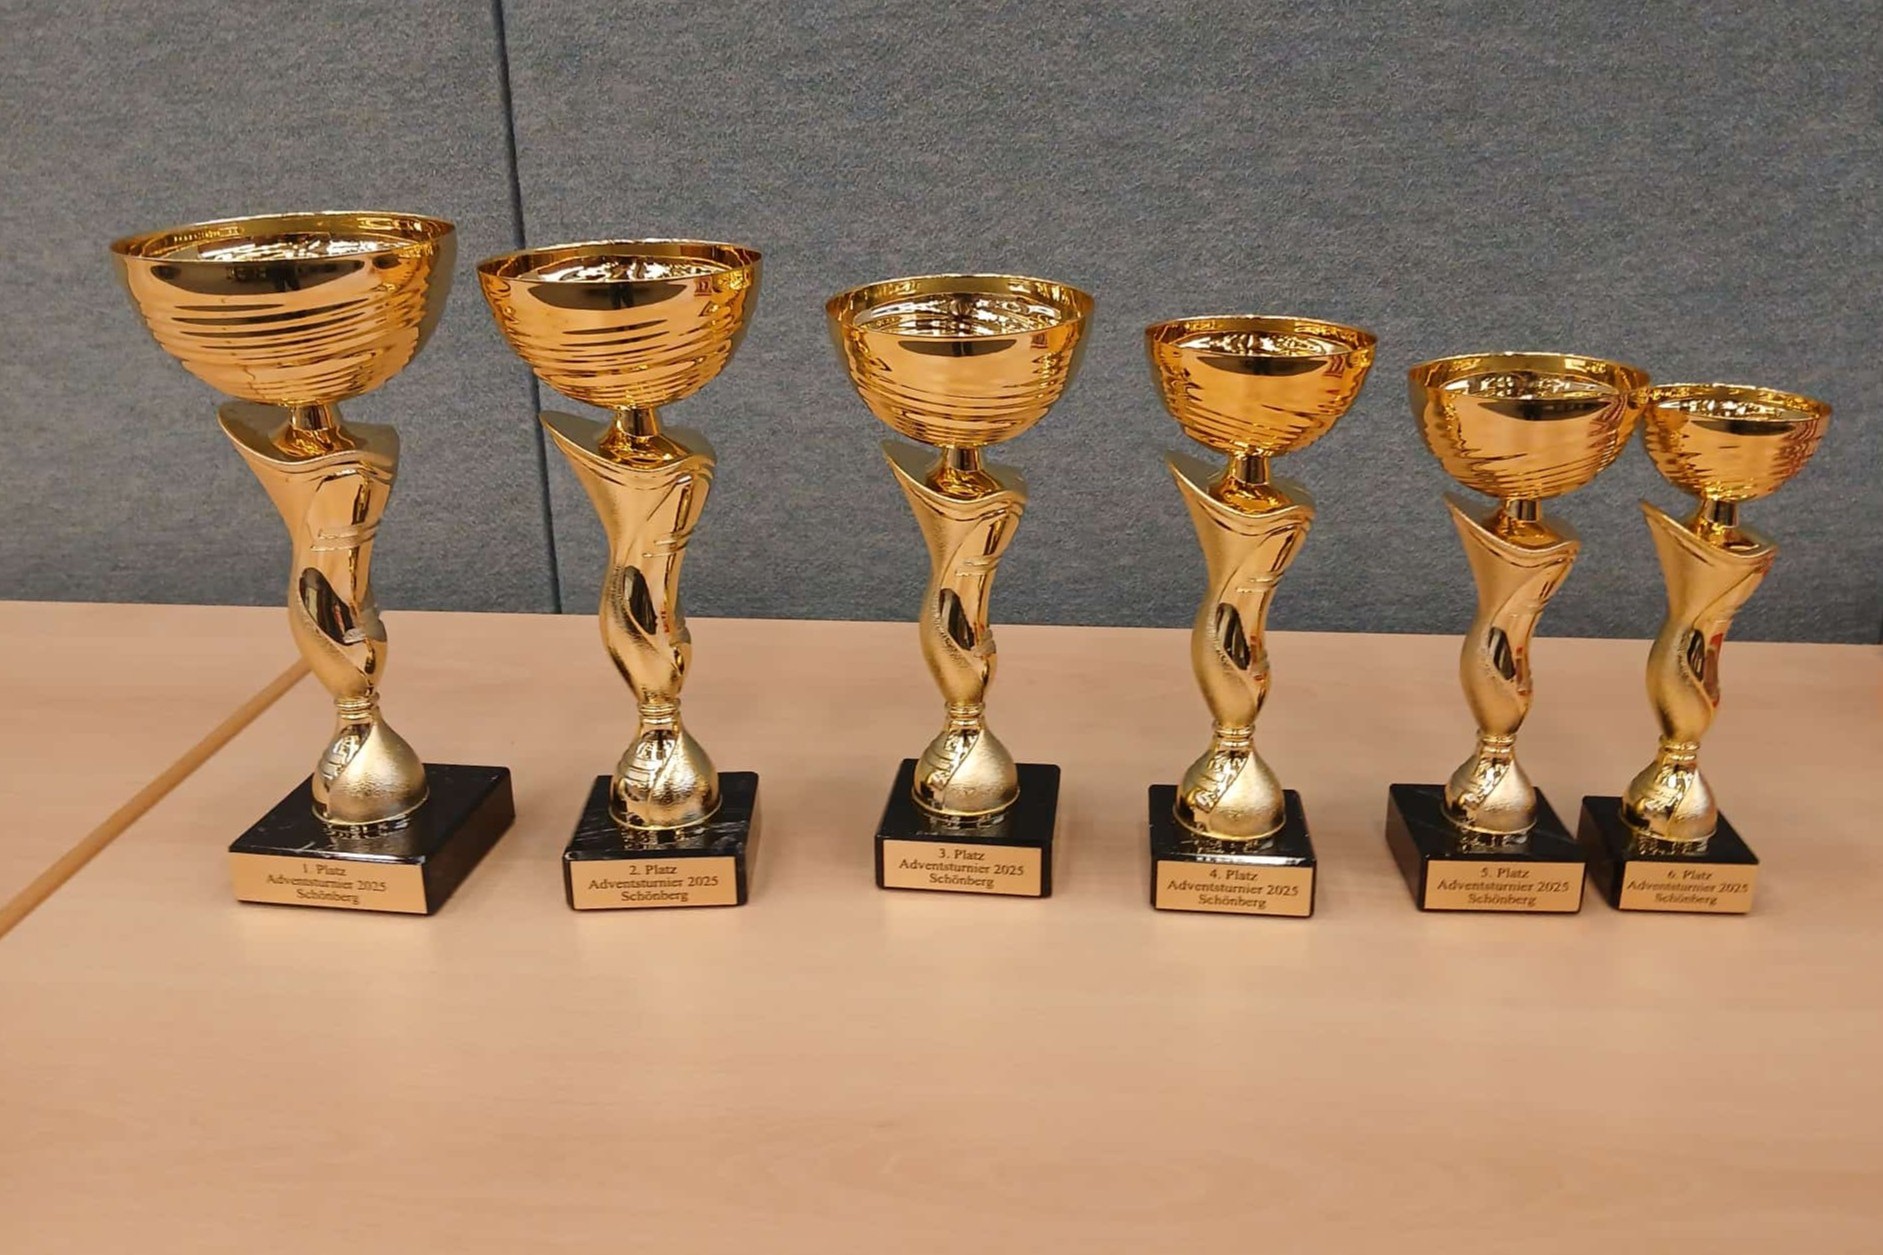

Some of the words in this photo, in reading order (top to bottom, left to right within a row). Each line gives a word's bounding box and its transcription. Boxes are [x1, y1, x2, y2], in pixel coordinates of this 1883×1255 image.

[938, 848, 950, 859] 3.
[954, 849, 986, 861] Platz
[316, 864, 347, 876] Platz
[645, 864, 678, 875] Platz
[898, 858, 990, 874] Adventsturnier
[994, 864, 1024, 876] 2025
[1497, 868, 1530, 879] Platz
[929, 873, 995, 889] Schönberg
[1225, 869, 1259, 881] Platz
[267, 874, 354, 890] Adventsturnier
[357, 880, 387, 892] 2025
[588, 878, 684, 890] Adventsturnier
[687, 876, 719, 888] 2025
[1167, 879, 1264, 895] Adventsturnier
[1266, 884, 1299, 897] 2025
[1437, 879, 1533, 892] Adventsturnier
[1537, 881, 1570, 893] 2025
[296, 889, 361, 905] Schönberg
[621, 891, 689, 902] Schönberg
[1198, 894, 1267, 909] Schönberg
[1468, 893, 1537, 907] Schönberg
